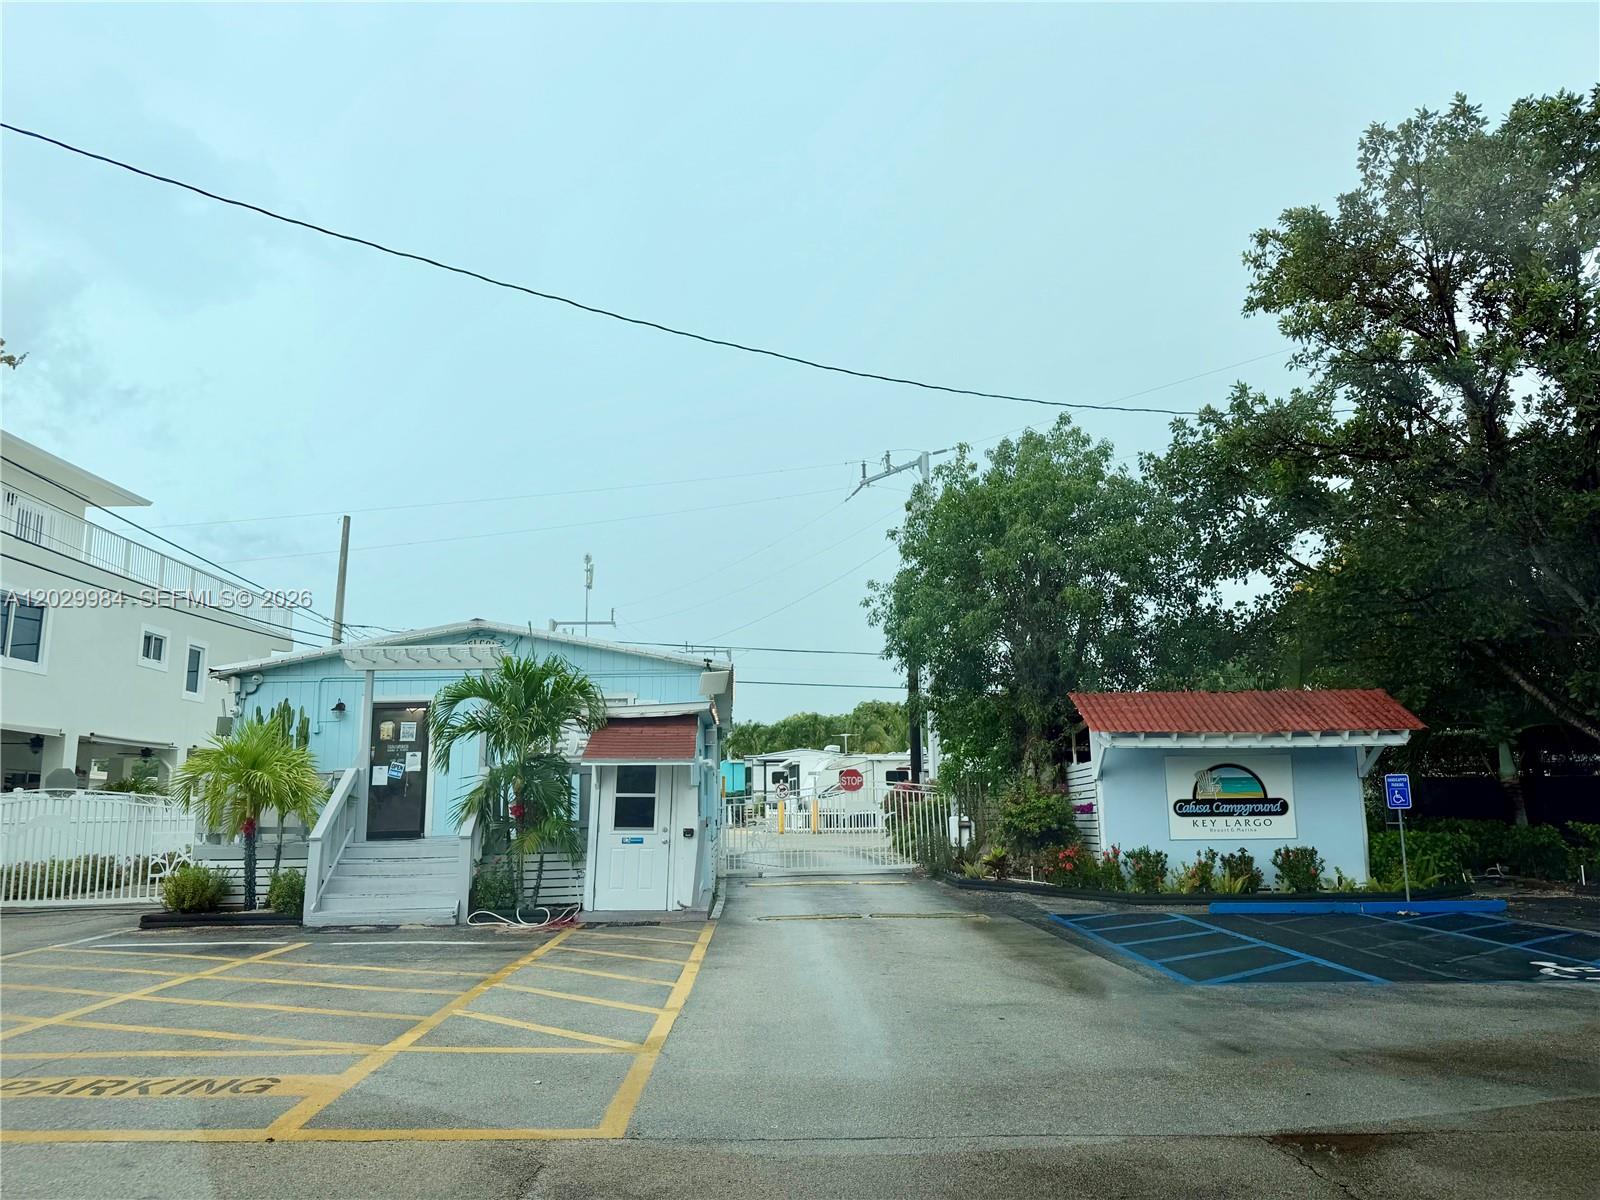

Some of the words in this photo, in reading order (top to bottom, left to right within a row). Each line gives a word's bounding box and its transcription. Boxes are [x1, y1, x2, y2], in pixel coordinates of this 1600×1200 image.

[841, 776, 862, 785] STOP
[1175, 801, 1210, 813] Calusa
[1212, 800, 1282, 815] Campground
[1192, 819, 1217, 828] KEY
[1225, 818, 1273, 828] LARGO
